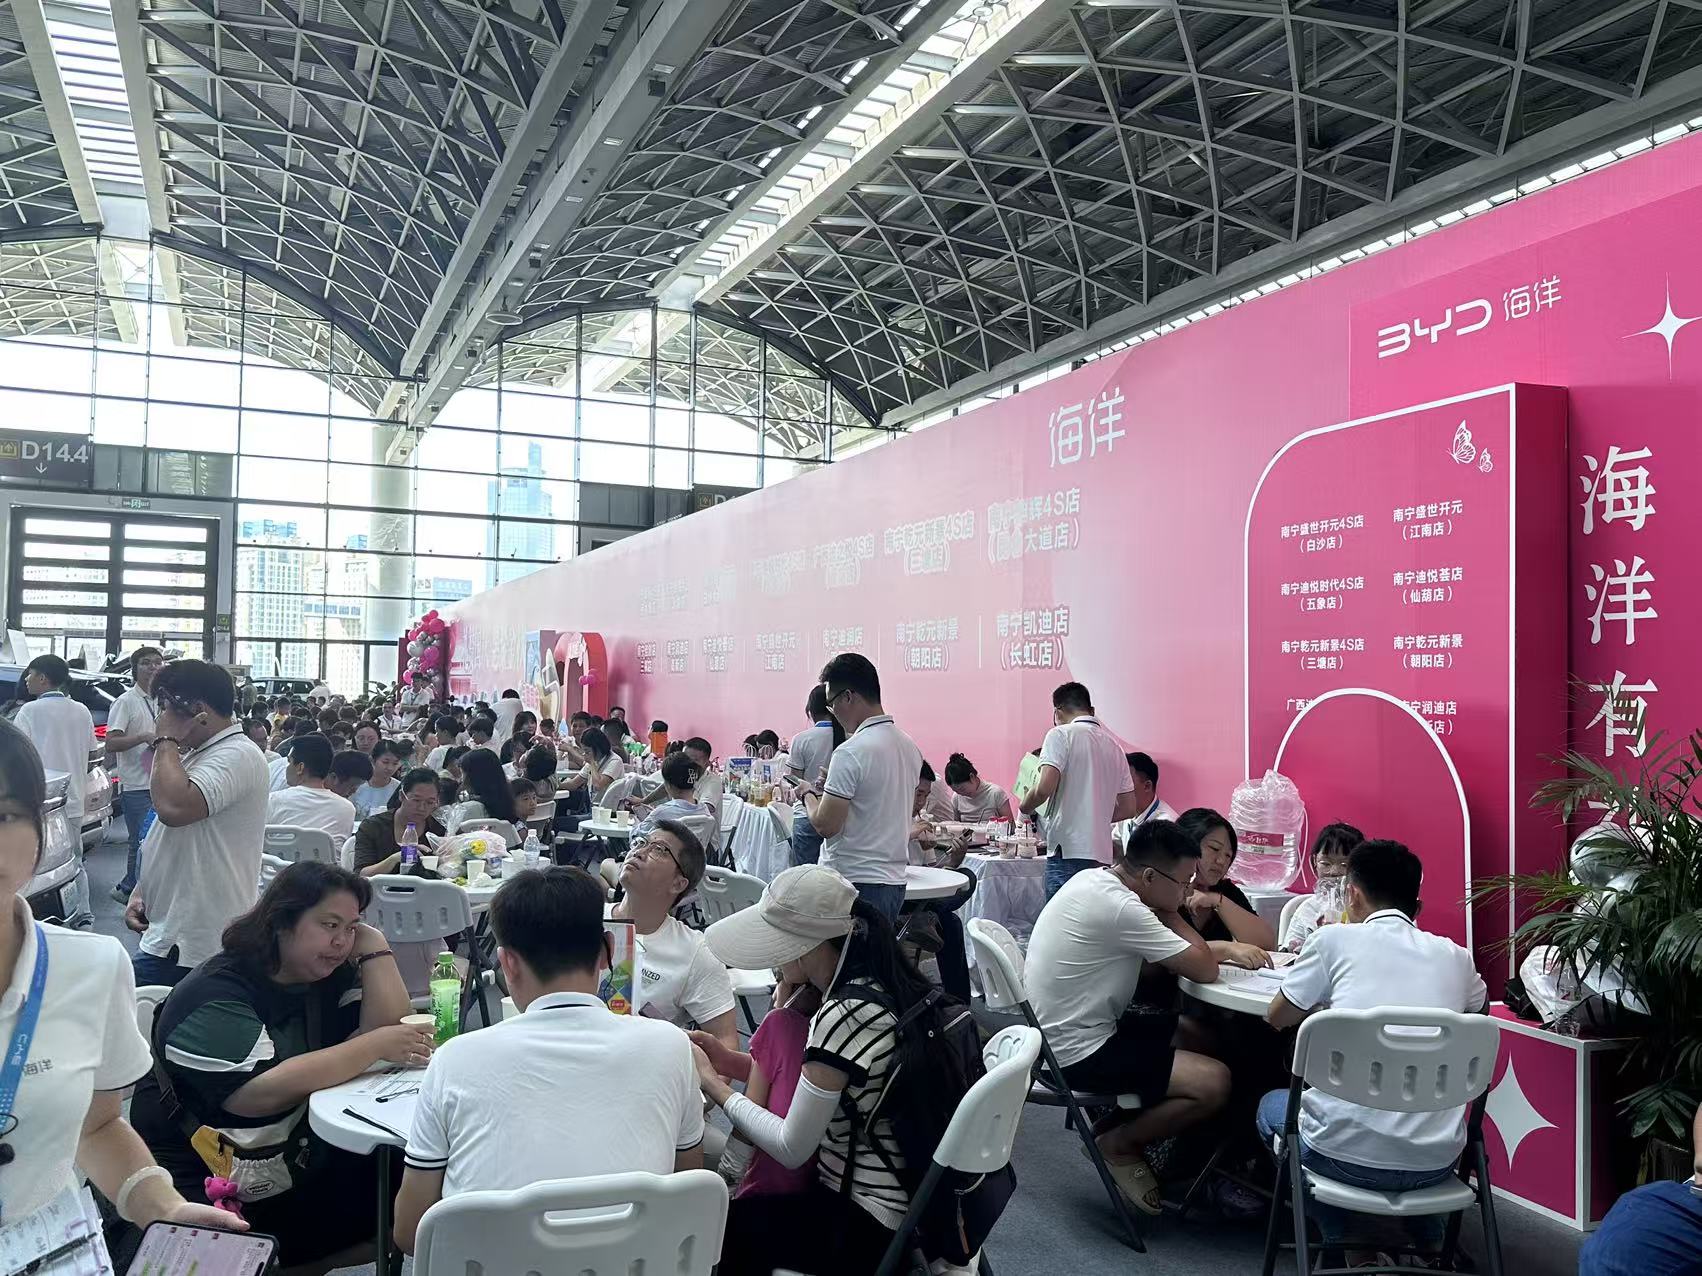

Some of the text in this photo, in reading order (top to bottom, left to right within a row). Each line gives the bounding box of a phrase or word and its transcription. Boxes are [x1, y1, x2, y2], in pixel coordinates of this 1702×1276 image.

[1378, 275, 1562, 359] BYD 海洋
[1049, 386, 1127, 468] 海洋
[21, 441, 89, 464] D14.4
[1393, 499, 1463, 523] 南宁盛世开元
[1281, 514, 1364, 539] 南宁盛世开元4S店
[1402, 519, 1453, 541] （江南店）
[1300, 534, 1343, 553] （白沙店）
[997, 608, 1069, 637] 南宁凯迪店
[1001, 637, 1063, 670] （长虹店）
[1281, 638, 1365, 653] 南宁乾元新景4S店
[1394, 633, 1463, 651] 南宁乾元新景
[1403, 652, 1453, 669] （朝阳店）
